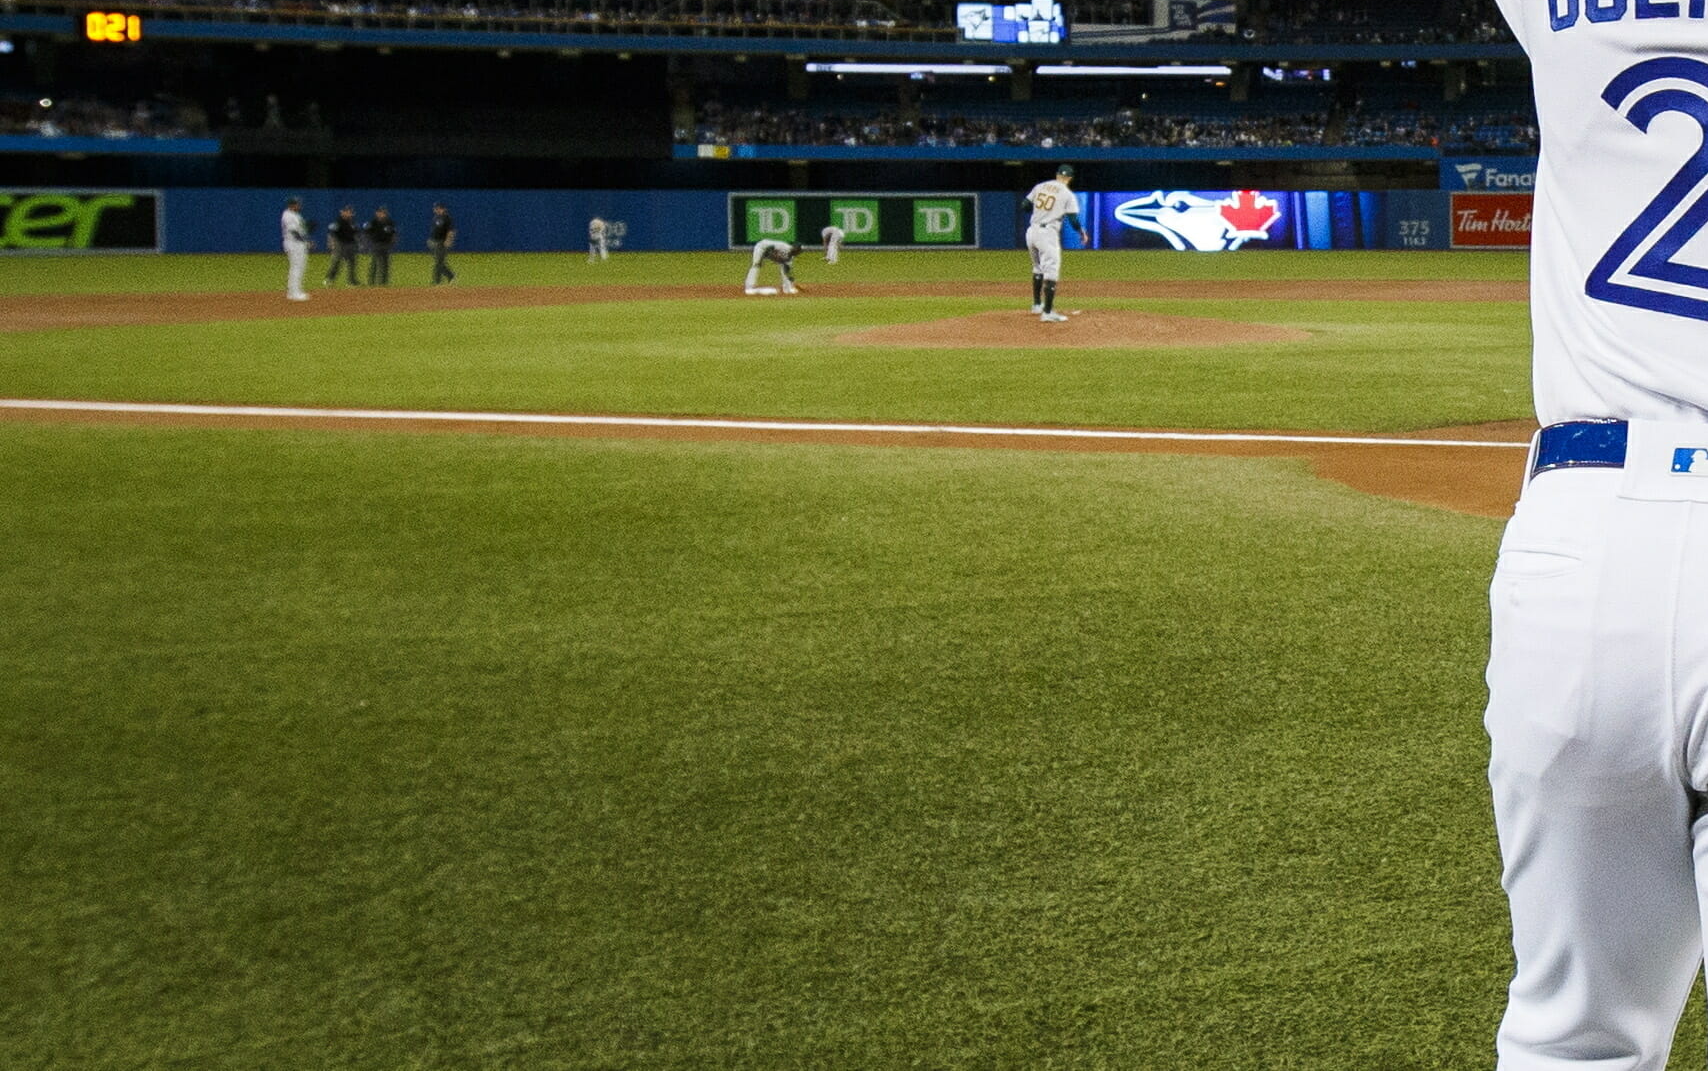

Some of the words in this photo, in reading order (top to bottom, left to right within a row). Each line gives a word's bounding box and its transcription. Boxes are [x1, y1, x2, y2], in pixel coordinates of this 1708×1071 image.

[1035, 192, 1056, 212] 50
[0, 193, 136, 248] er
[750, 207, 790, 234] TD
[834, 207, 874, 234] TD
[918, 207, 957, 234] TD
[1399, 220, 1430, 236] 375
[1457, 209, 1488, 232] Tim
[1490, 209, 1532, 233] Hort
